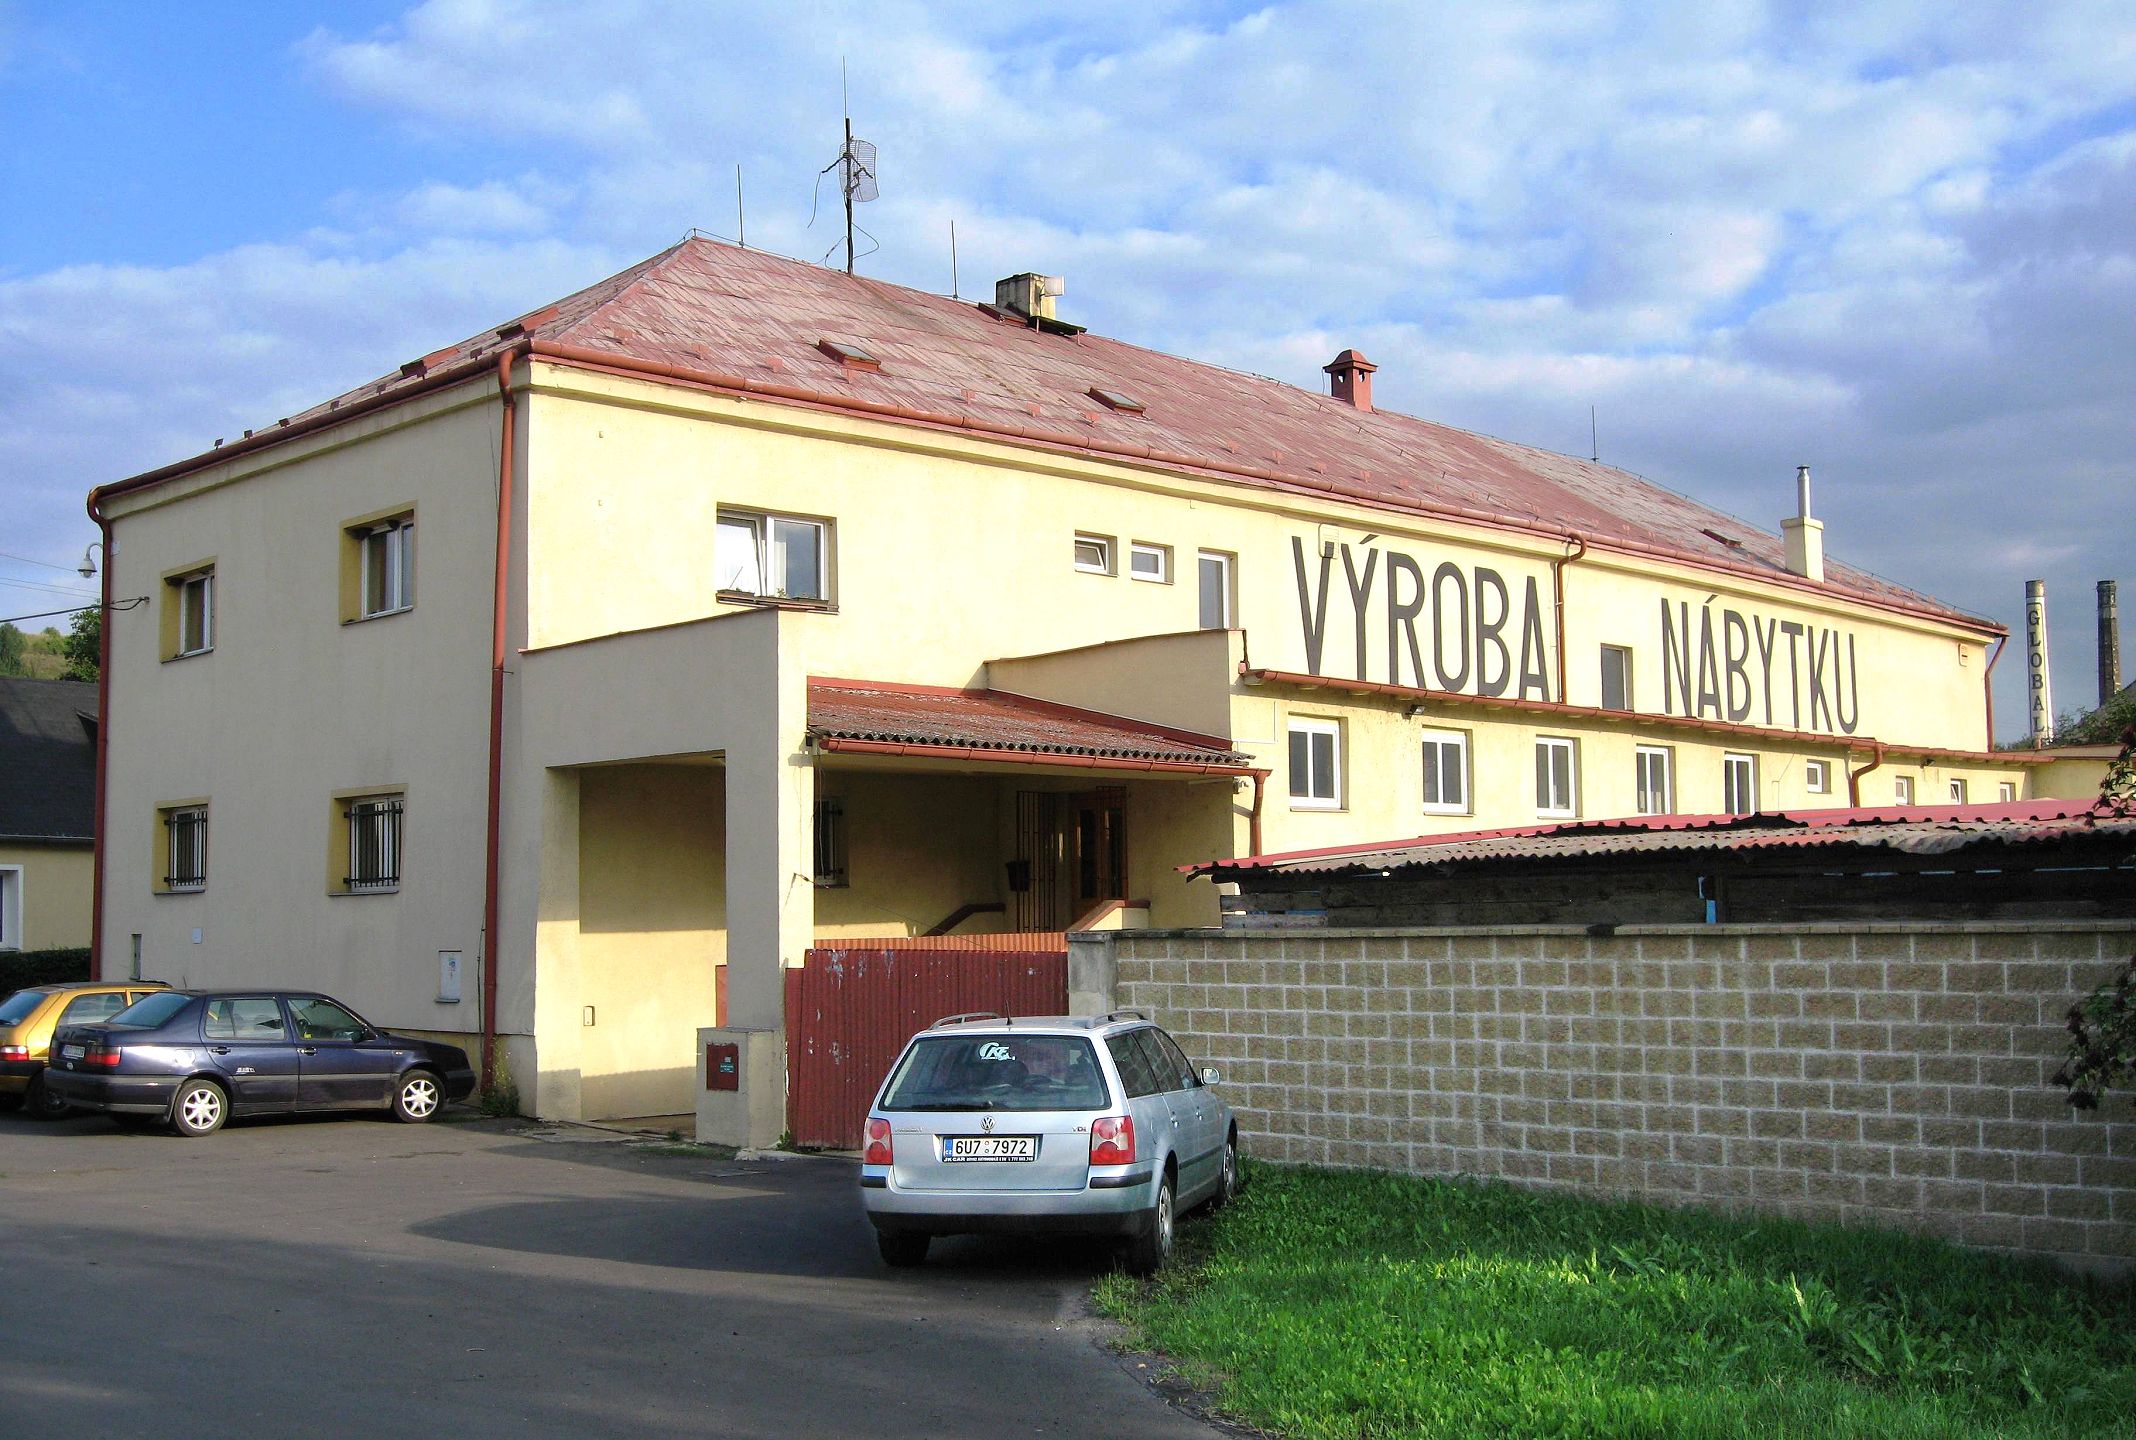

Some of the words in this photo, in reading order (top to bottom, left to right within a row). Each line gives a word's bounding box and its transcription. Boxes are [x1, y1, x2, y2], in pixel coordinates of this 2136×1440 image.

[1291, 533, 1551, 702] VÝROBA
[1661, 594, 1858, 734] NÁBYTKU
[2028, 610, 2045, 732] GLOBAL
[955, 1140, 981, 1155] 6U7
[992, 1140, 1027, 1155] 7972
